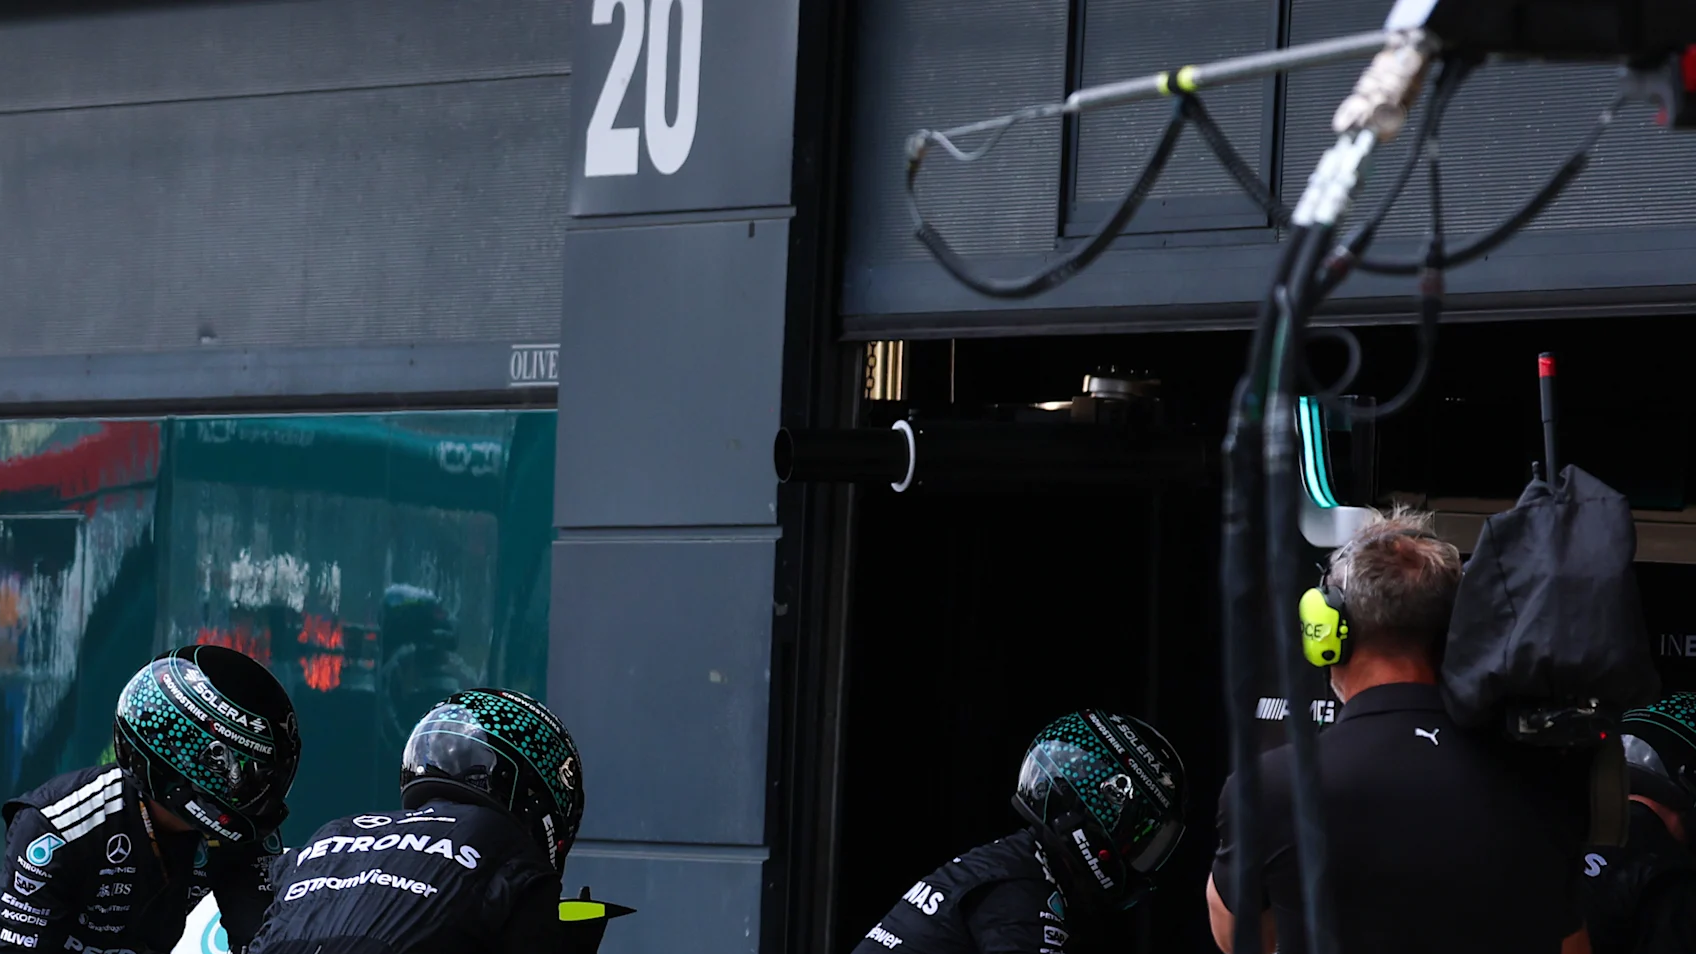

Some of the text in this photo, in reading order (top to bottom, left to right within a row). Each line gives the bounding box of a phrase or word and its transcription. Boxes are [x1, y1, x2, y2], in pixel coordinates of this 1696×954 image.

[584, 0, 703, 178] 20
[510, 350, 559, 380] OLIVE
[162, 673, 209, 722] CROWDSTRIKE
[193, 681, 249, 728] SOLERA
[501, 691, 562, 735] CROWDSTRIKE
[213, 721, 274, 755] CROWDSTRIKE
[1087, 712, 1127, 756] CROWDSTRIKE
[1116, 722, 1161, 775] SOLERA
[1127, 758, 1172, 810] CROWDSTRIKE
[184, 800, 243, 842] Einhell
[296, 833, 482, 869] PETRONAS
[1072, 828, 1114, 890] Einhell
[1, 892, 52, 916] Einhell
[1, 908, 48, 927] AKKODIS
[0, 927, 39, 949] nuvei
